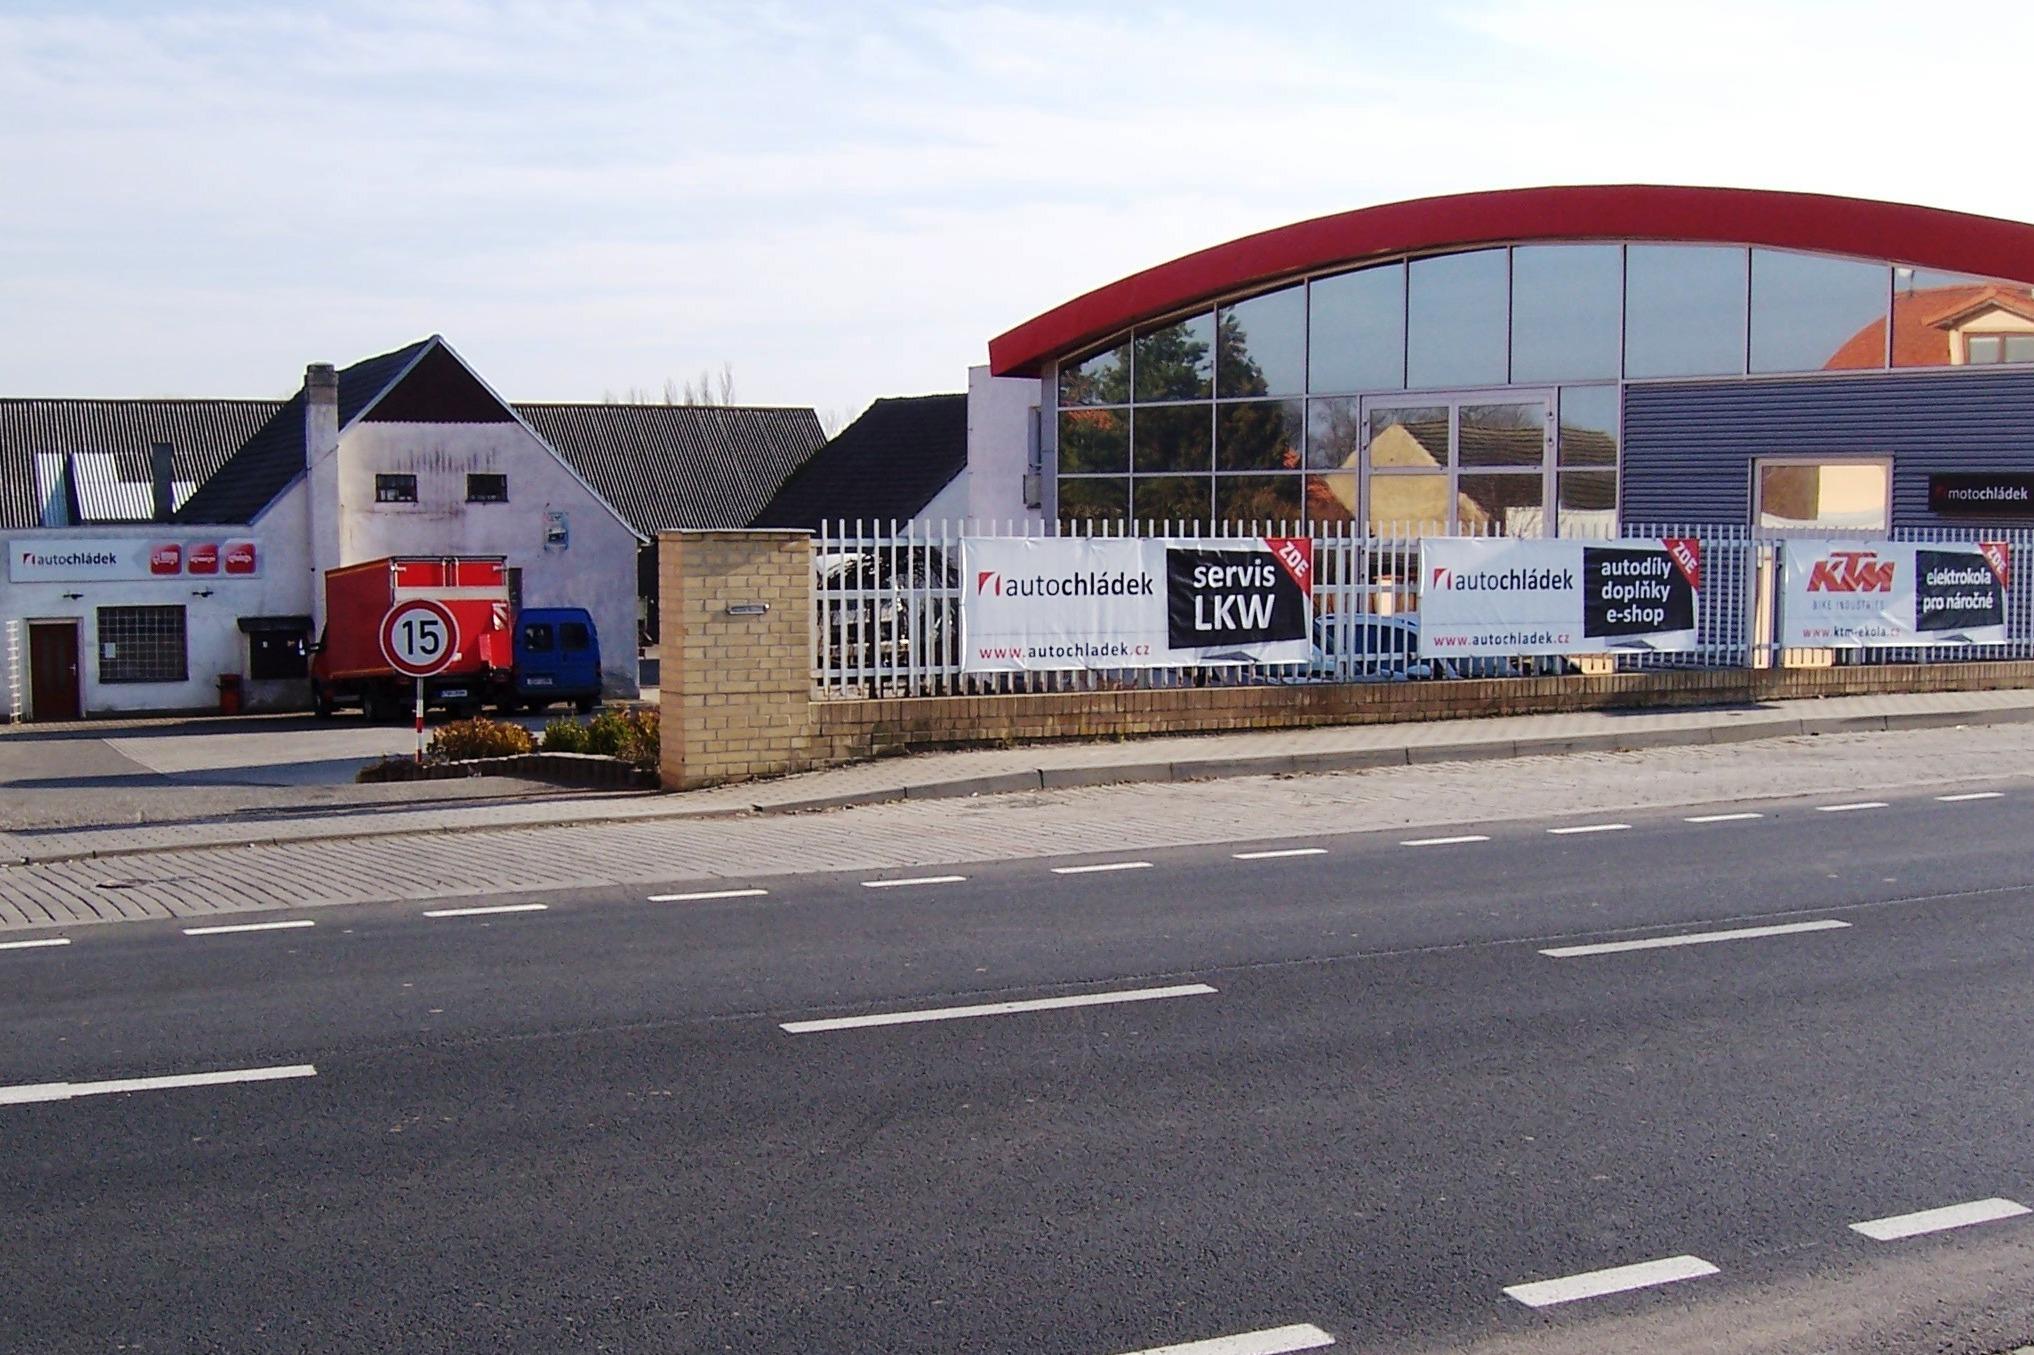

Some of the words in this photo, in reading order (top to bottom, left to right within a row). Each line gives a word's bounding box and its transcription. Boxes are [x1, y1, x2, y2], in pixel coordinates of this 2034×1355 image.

[1948, 486, 2028, 500] motochládek
[37, 552, 117, 566] autochládek
[1277, 541, 1309, 579] ZDE
[1601, 557, 1672, 579] autodíly
[1672, 541, 1698, 575] ZDE
[1193, 559, 1276, 589] servis
[1455, 568, 1573, 591] autochládek
[1806, 552, 1896, 592] KTM
[1926, 567, 1992, 586] elektrokola
[1006, 571, 1153, 596] autochládek
[1601, 580, 1671, 602] doplňky
[1194, 594, 1276, 631] LKW
[1923, 597, 1945, 614] pro
[1949, 592, 1994, 610] náročné
[1606, 604, 1664, 625] e-shop
[402, 620, 439, 655] 15
[1433, 632, 1570, 647] www.autochladek.cz
[979, 643, 1150, 659] www.autochladek.cz
